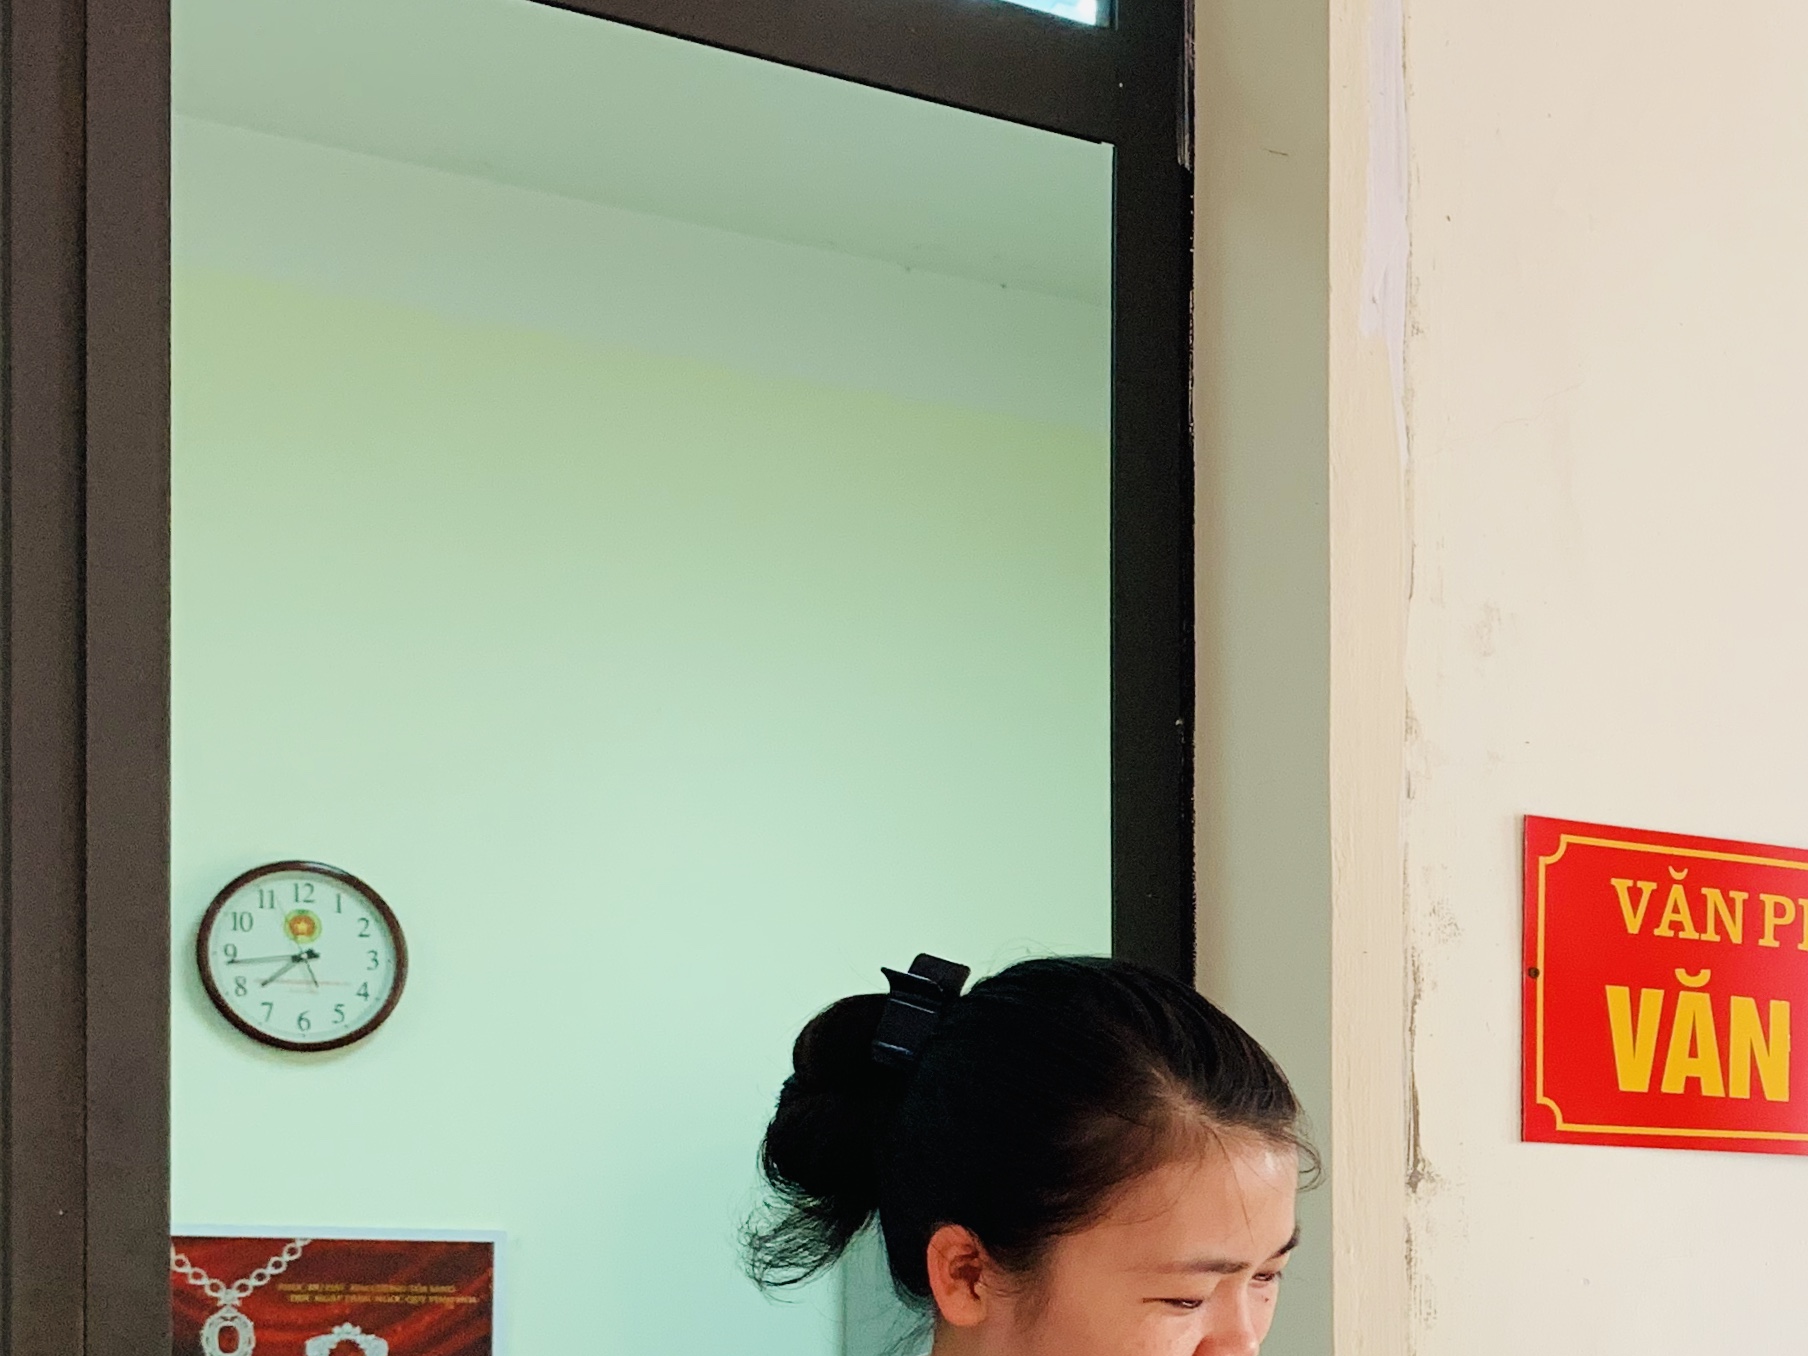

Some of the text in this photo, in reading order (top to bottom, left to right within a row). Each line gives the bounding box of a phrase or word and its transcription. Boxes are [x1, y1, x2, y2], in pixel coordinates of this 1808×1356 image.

[257, 888, 275, 910] 11
[293, 882, 315, 903] 12
[335, 893, 342, 914] 1
[1610, 865, 1747, 944] VĂN
[231, 911, 254, 932] 10
[357, 917, 370, 938] 2
[366, 950, 379, 971] 3
[234, 975, 248, 997] 8
[355, 981, 370, 1001] 4
[260, 1002, 274, 1022] 7
[297, 1010, 311, 1031] 6
[331, 1003, 345, 1024] 5
[1604, 967, 1790, 1103] VĂN
